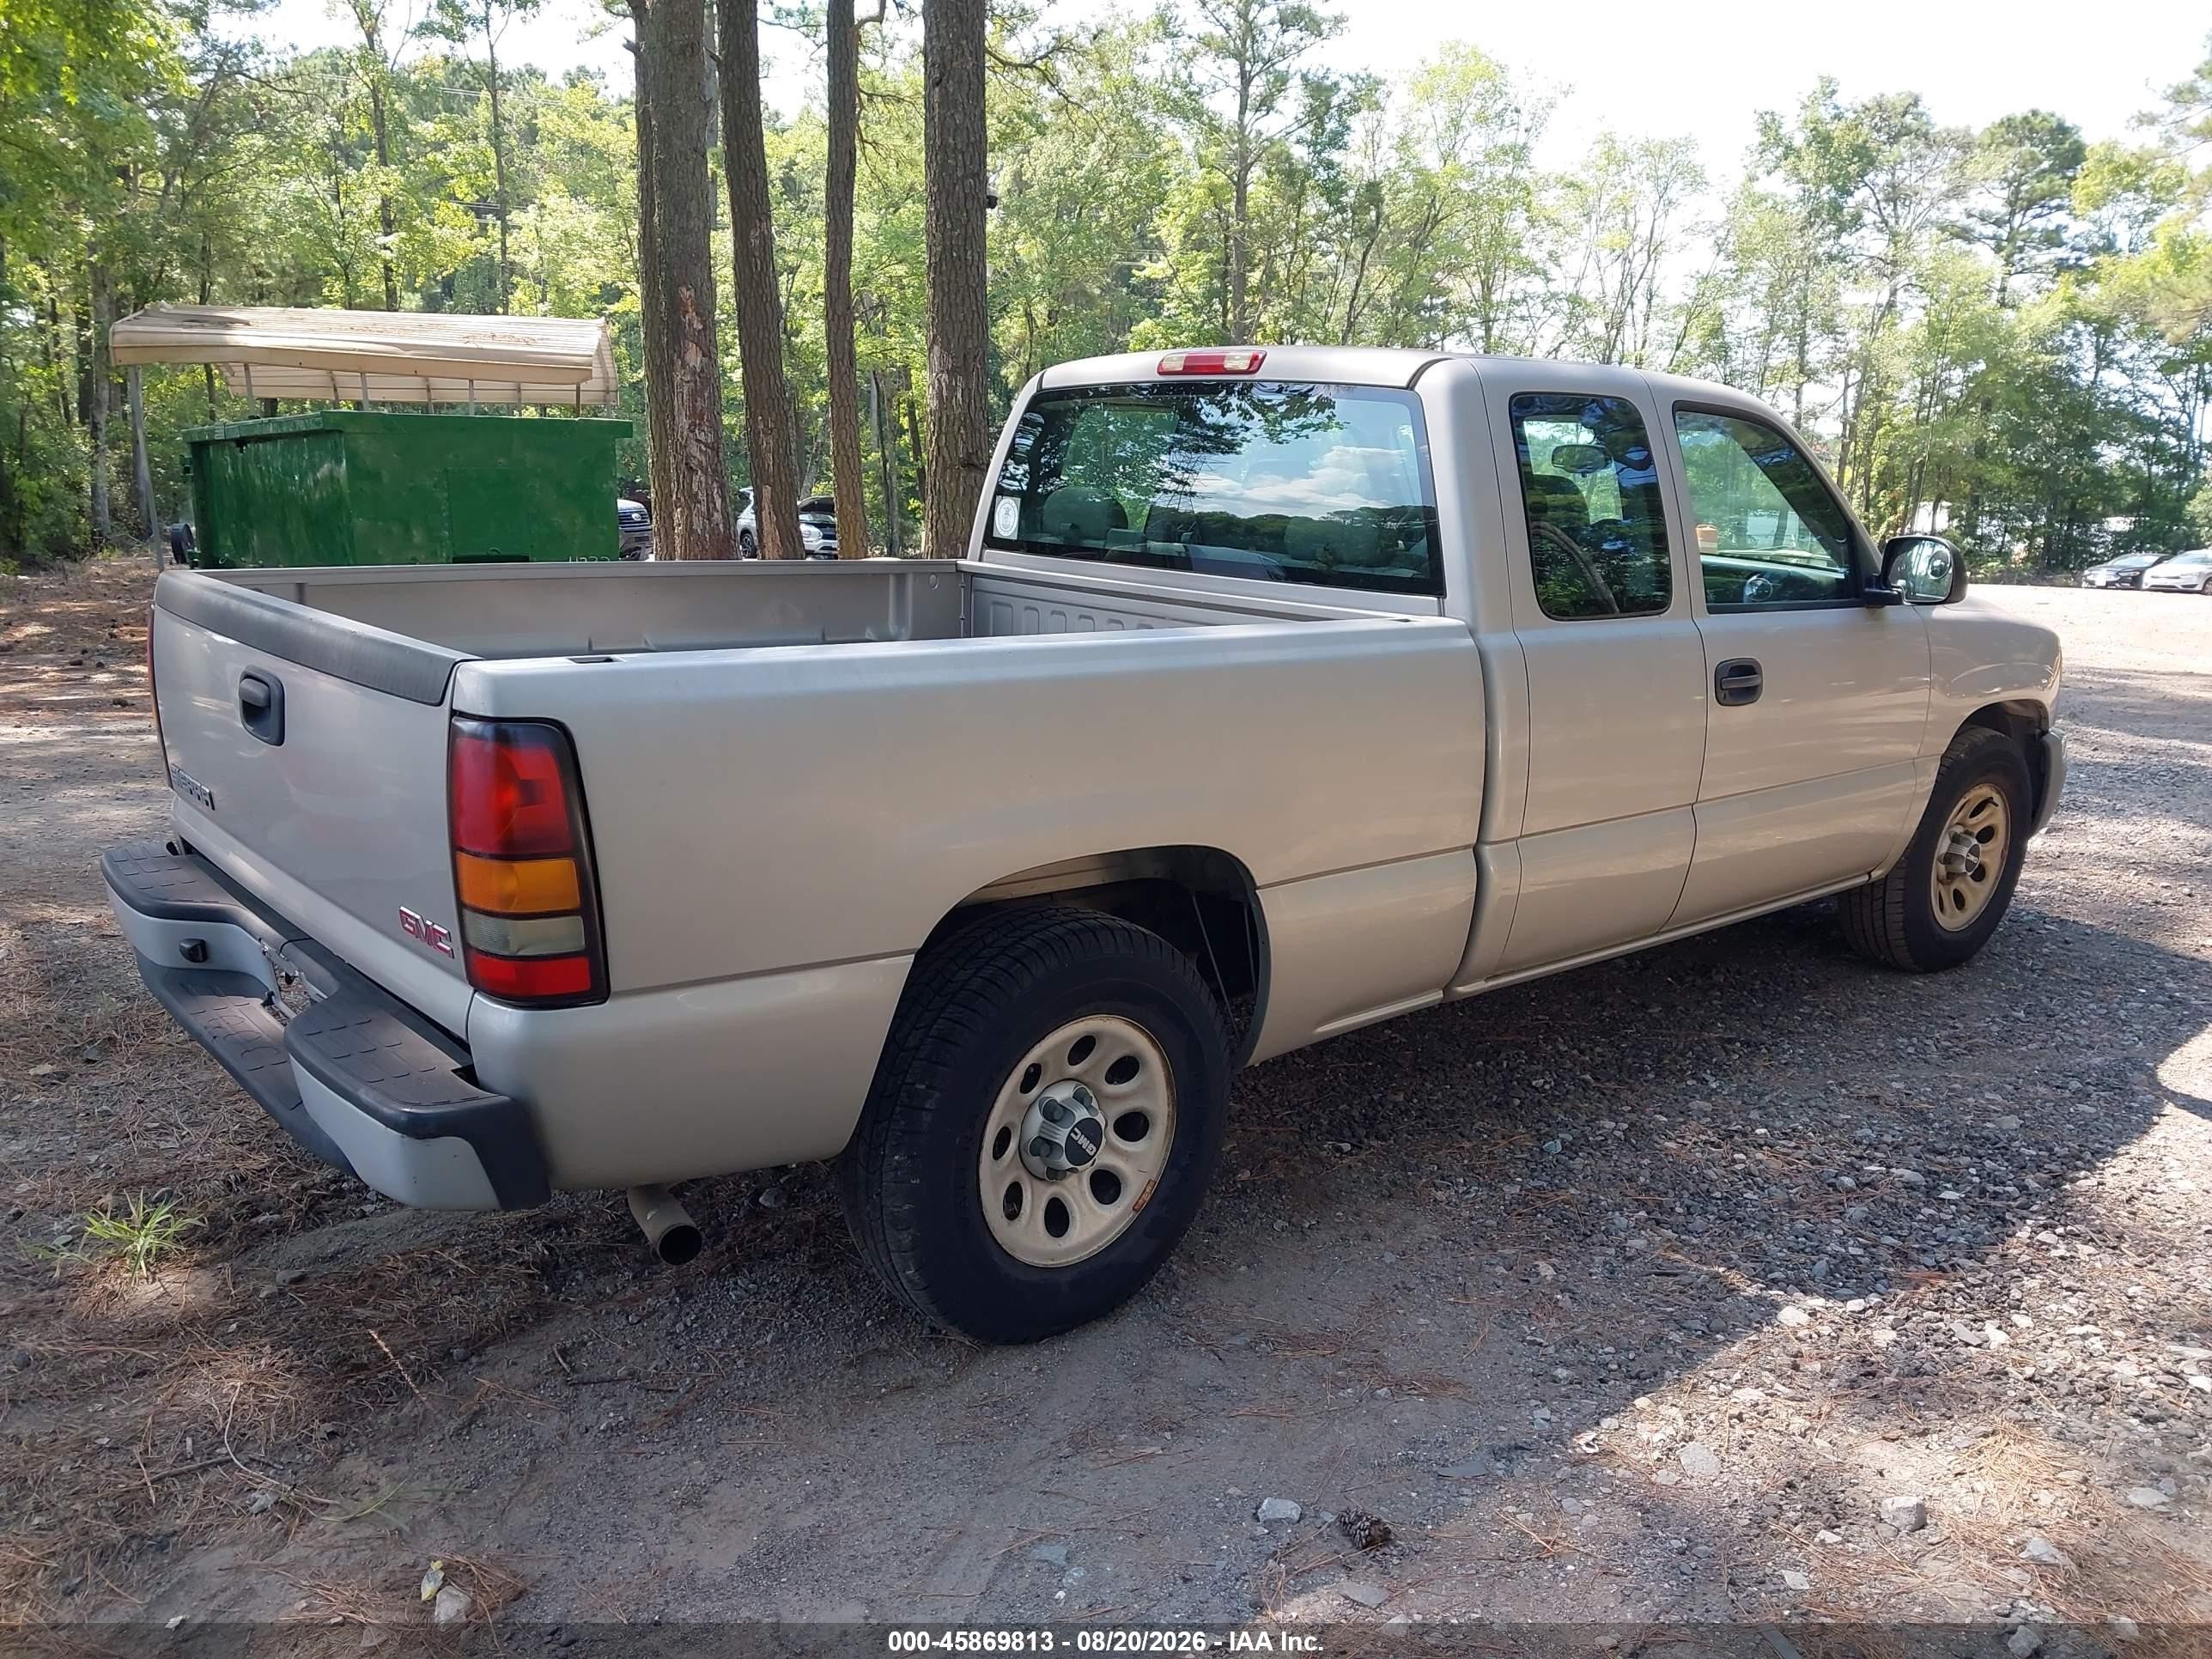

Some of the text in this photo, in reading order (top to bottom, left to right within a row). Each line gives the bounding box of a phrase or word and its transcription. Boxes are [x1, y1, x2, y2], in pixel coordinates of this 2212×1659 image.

[1966, 853, 1978, 864] GMC
[398, 906, 455, 959] GMC
[1070, 1127, 1097, 1157] GMC
